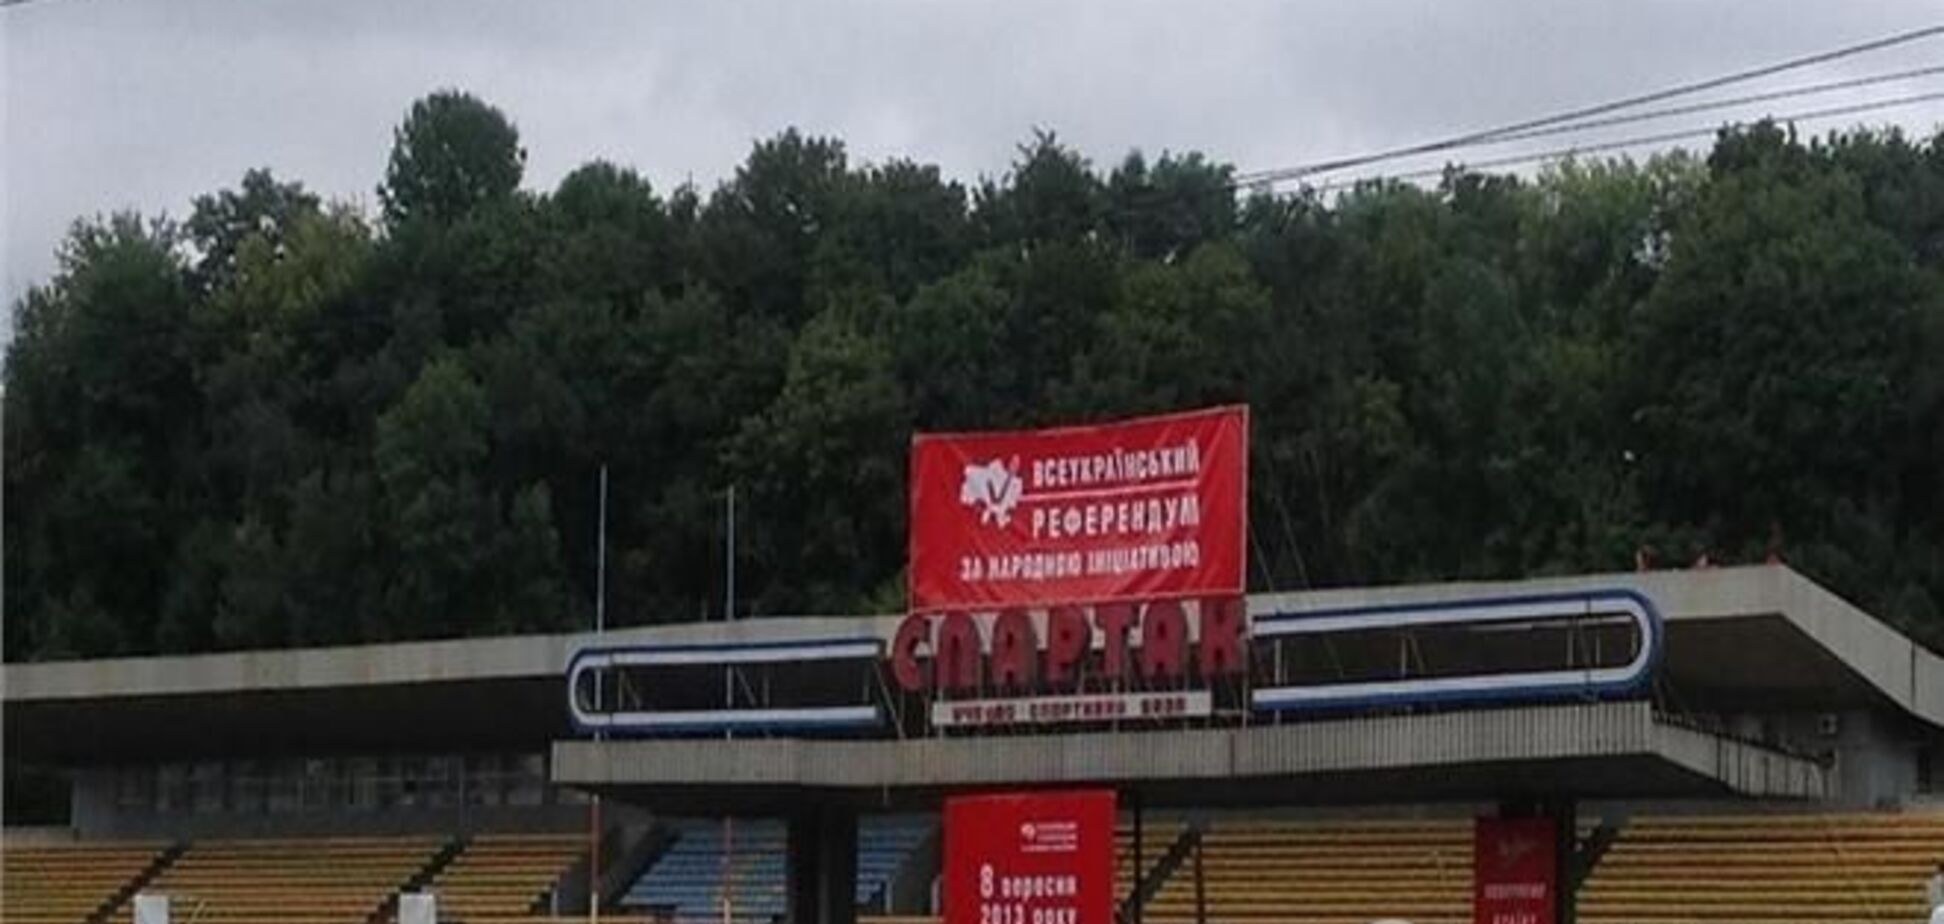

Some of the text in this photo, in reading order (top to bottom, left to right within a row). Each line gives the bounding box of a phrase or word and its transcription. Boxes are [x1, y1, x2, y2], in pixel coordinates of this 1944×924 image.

[1033, 441, 1199, 488] ВСЕУКРАЇНСЬКИЙ
[1033, 494, 1199, 539] РЕФЕРЕНДУМ
[961, 540, 1199, 581] ЗА НАРОДНОЮ ІНІЦІАТИВОЮ
[893, 598, 1246, 691] СПАРТАК
[980, 864, 1077, 902] 8 вересня
[980, 903, 1025, 924] 2013
